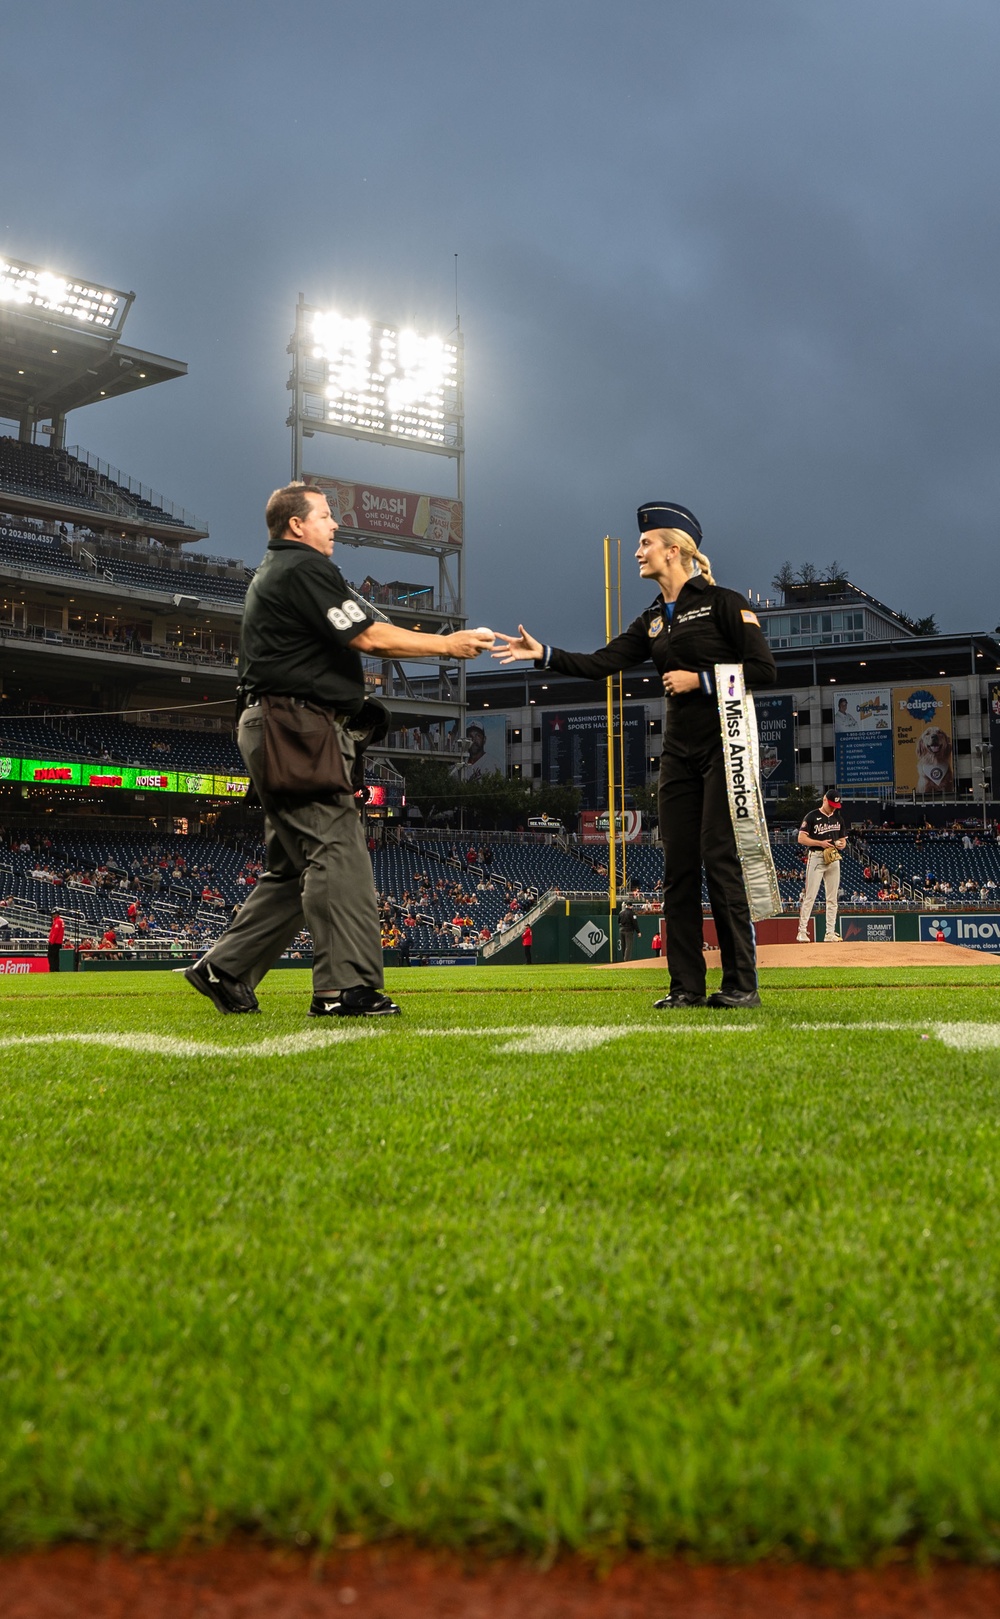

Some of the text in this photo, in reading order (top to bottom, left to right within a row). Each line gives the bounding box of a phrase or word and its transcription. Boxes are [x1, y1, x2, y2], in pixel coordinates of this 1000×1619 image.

[361, 490, 407, 518] SMASH
[365, 511, 404, 525] ONE OUT OF
[369, 519, 400, 531] THE PARK
[9, 529, 53, 544] 202.980.4357
[327, 599, 367, 631] 88
[900, 700, 943, 710] Pedigree
[593, 721, 607, 729] HALL
[760, 719, 787, 731] GIVING
[758, 731, 782, 742] ARDEN
[724, 700, 751, 819] Miss America
[136, 775, 162, 787] NOISE
